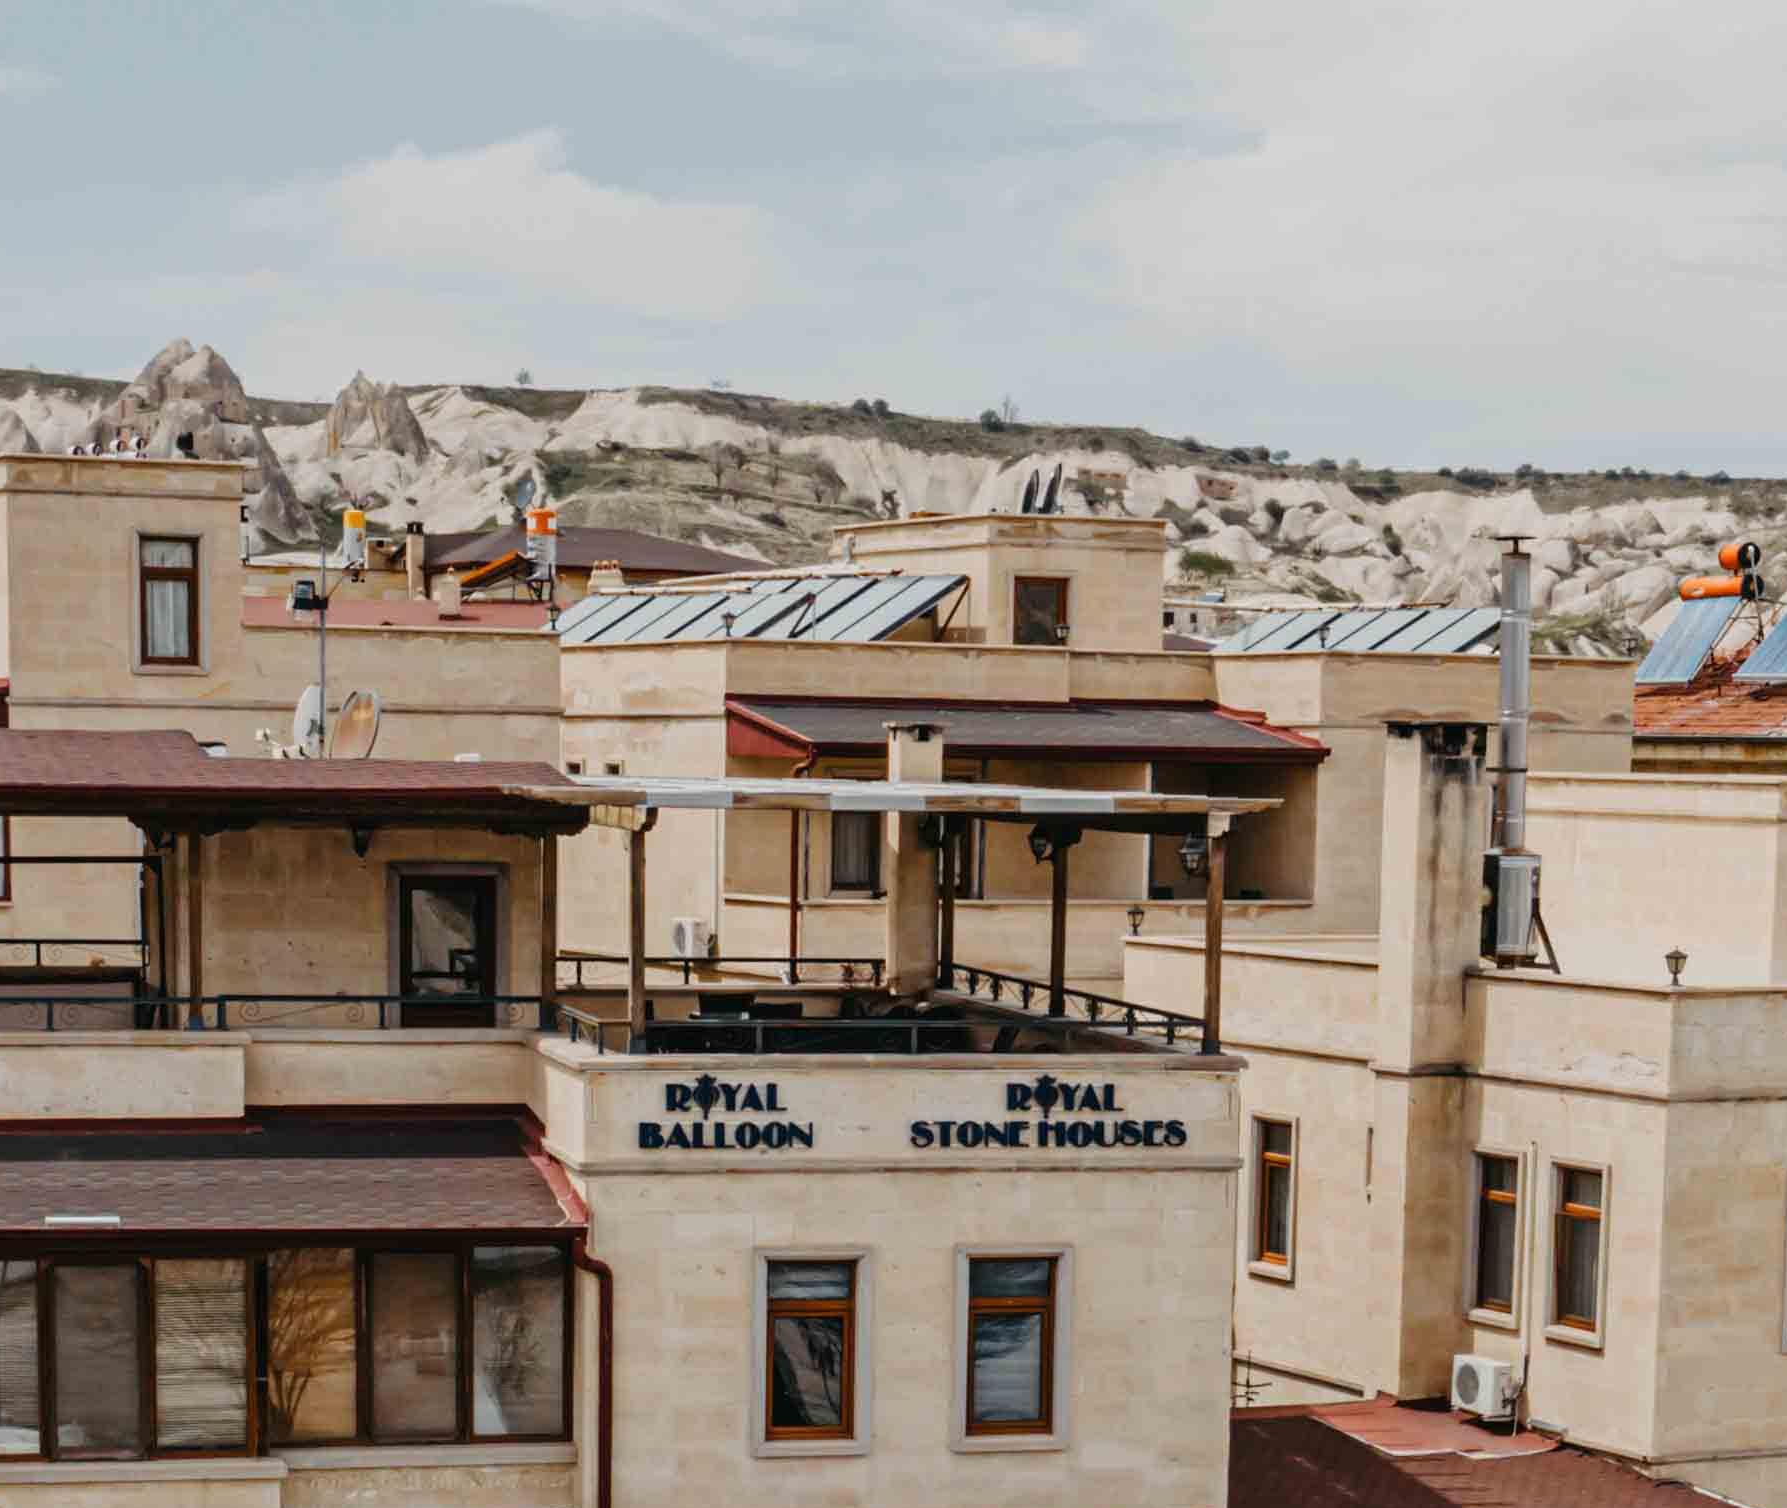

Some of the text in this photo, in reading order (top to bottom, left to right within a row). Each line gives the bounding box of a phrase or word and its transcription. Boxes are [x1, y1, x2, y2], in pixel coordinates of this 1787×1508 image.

[665, 1074, 787, 1120] ROYAL
[1006, 1074, 1124, 1119] ROYAL
[638, 1121, 814, 1149] BALLOON
[910, 1120, 1187, 1148] STONE HOUSES
